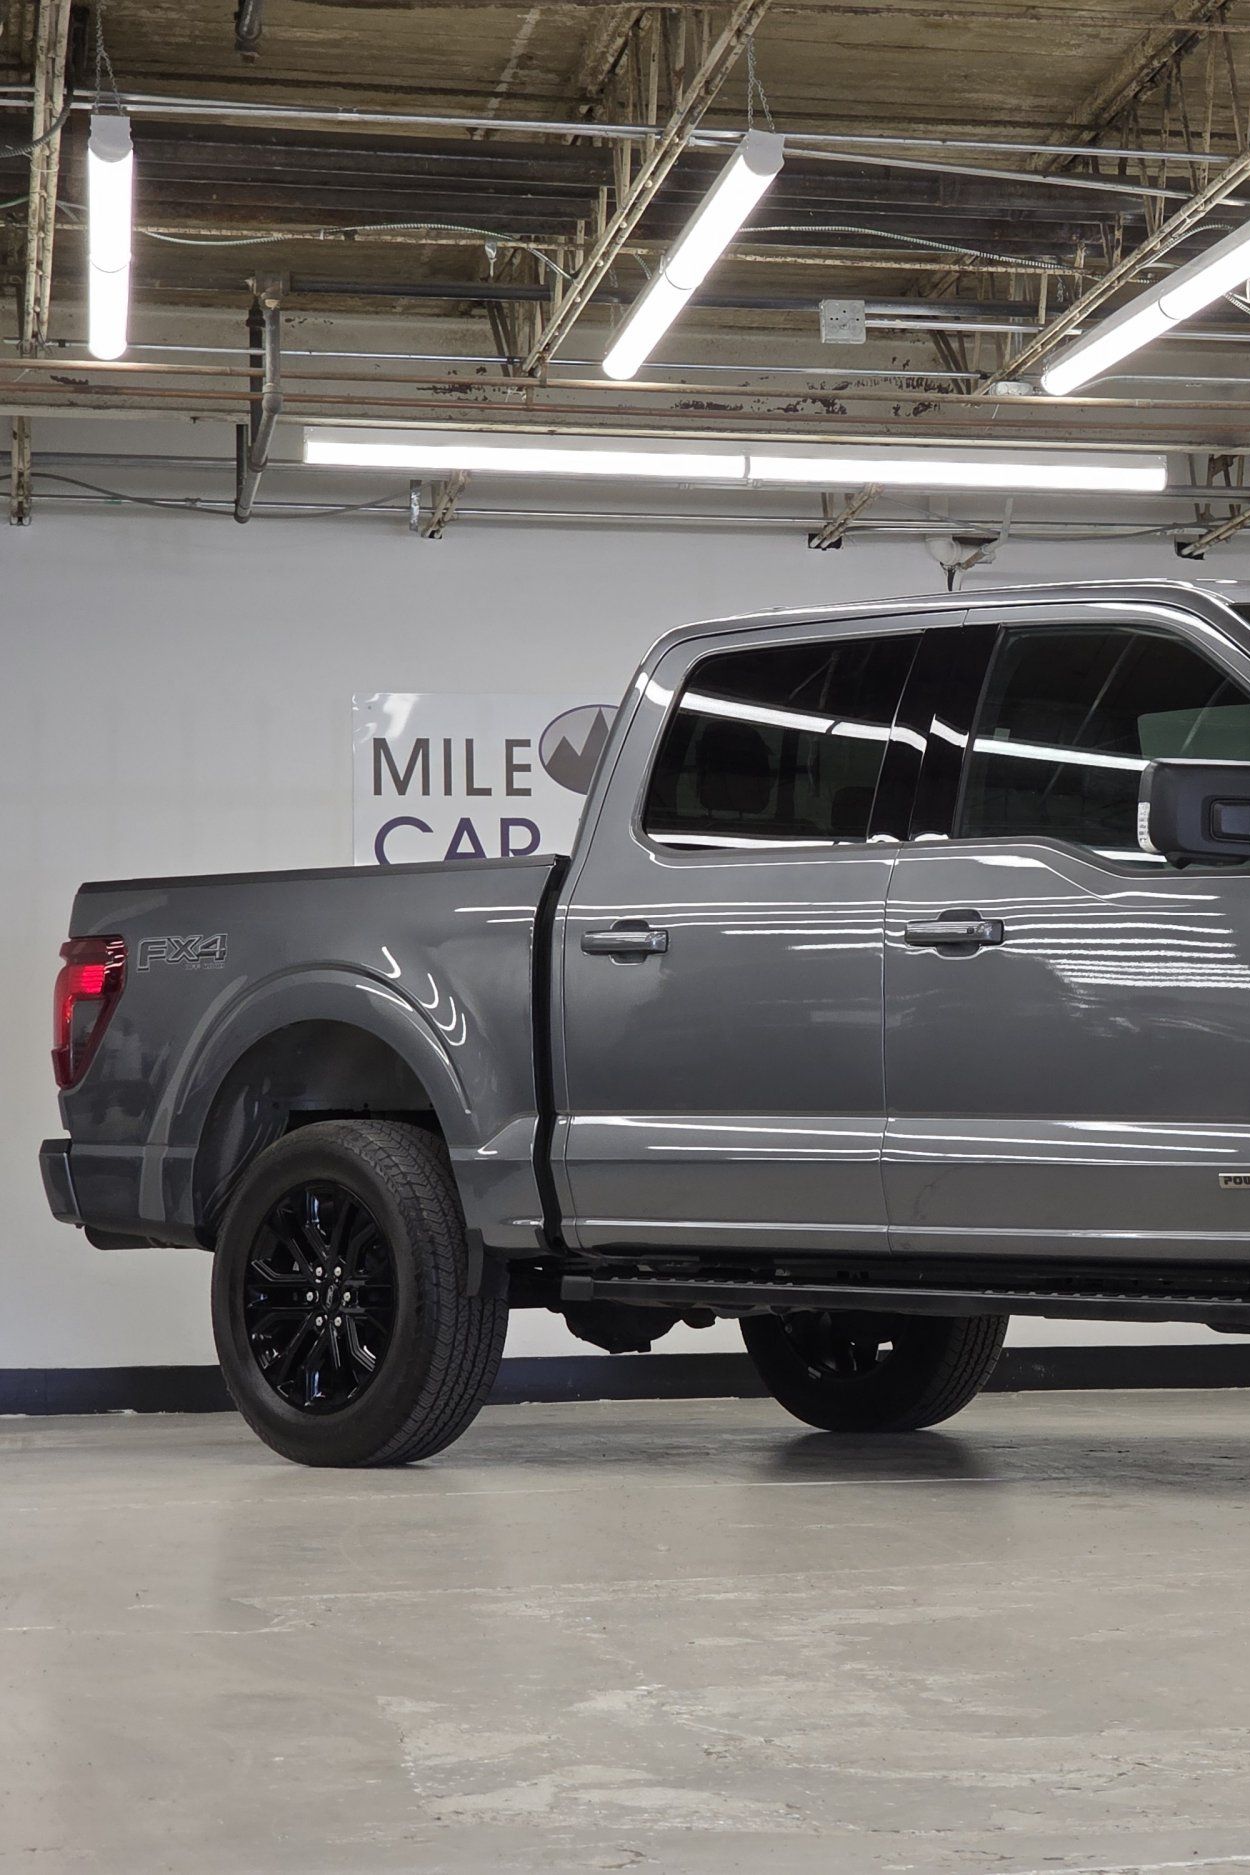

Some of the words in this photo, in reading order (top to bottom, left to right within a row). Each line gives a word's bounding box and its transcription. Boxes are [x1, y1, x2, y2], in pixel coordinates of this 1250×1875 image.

[373, 737, 532, 797] MILE
[374, 816, 541, 866] CAR
[137, 933, 228, 973] FX4
